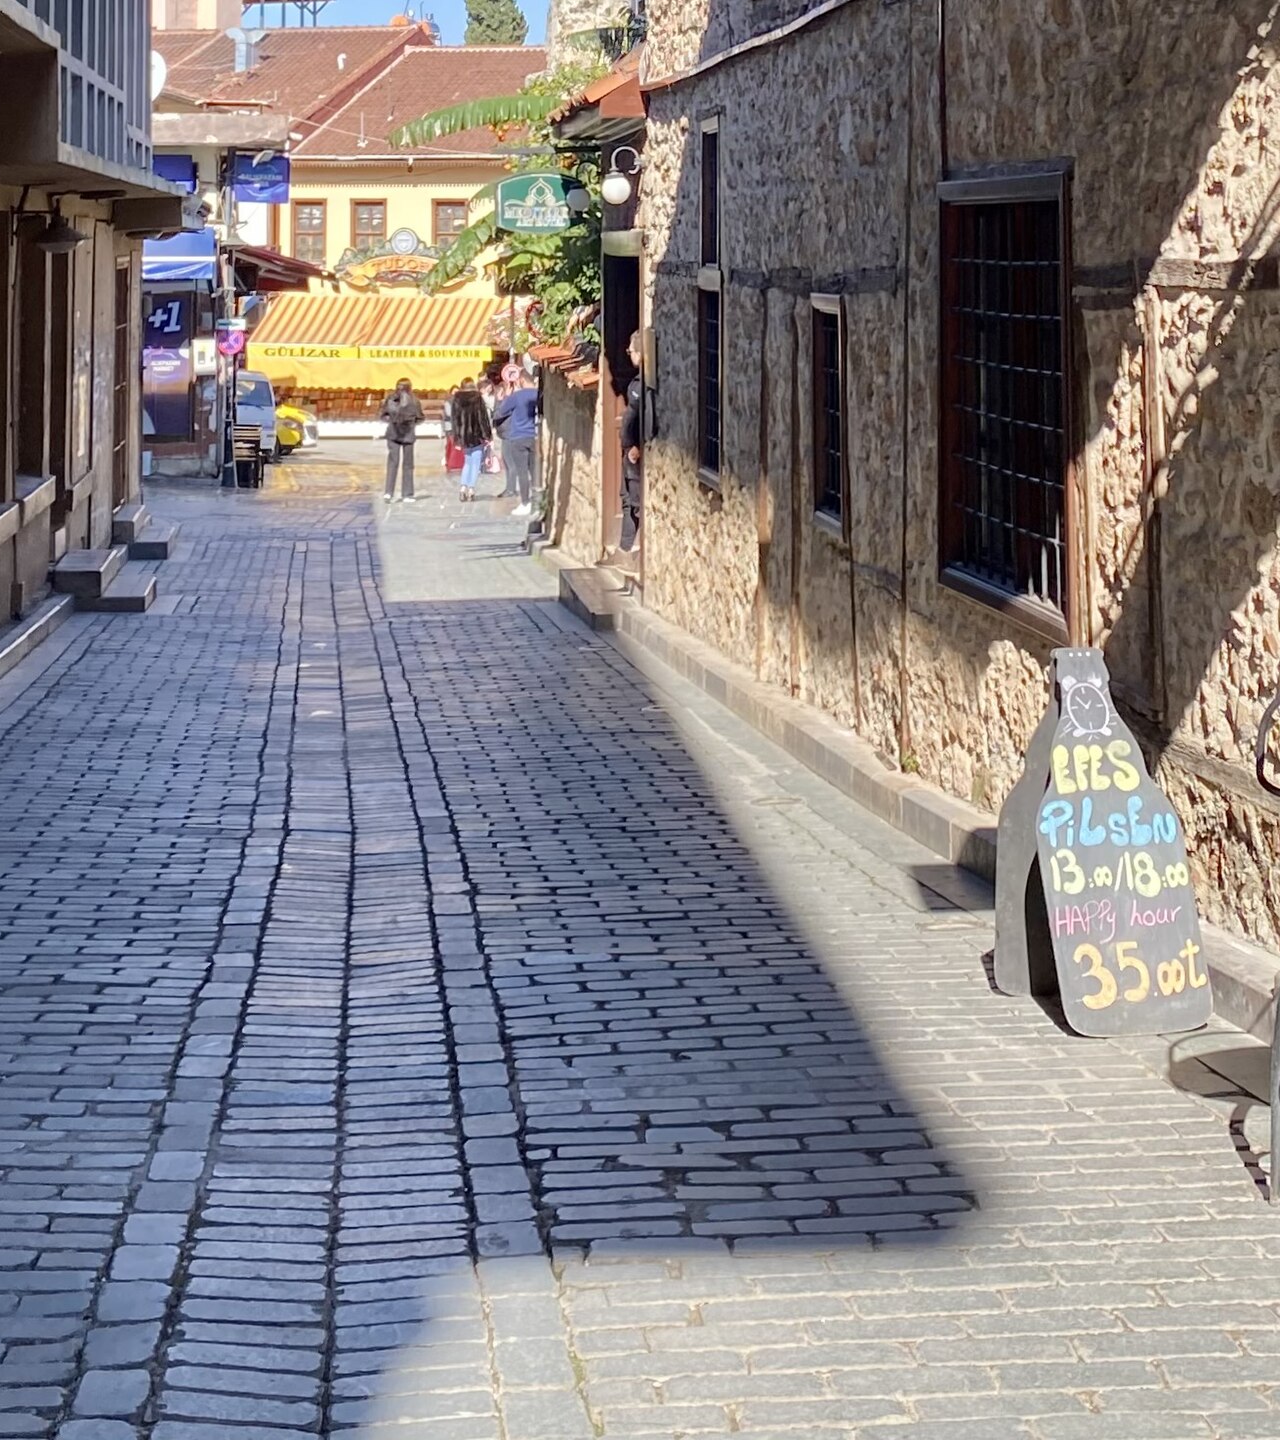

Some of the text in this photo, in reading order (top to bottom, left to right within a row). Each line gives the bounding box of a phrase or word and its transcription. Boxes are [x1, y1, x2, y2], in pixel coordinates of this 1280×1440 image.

[148, 301, 181, 333] +1
[264, 345, 481, 358] GÜLİZAR LEATHER & SOUVENIR
[1053, 739, 1141, 795] EFES
[1130, 899, 1183, 927] hour
